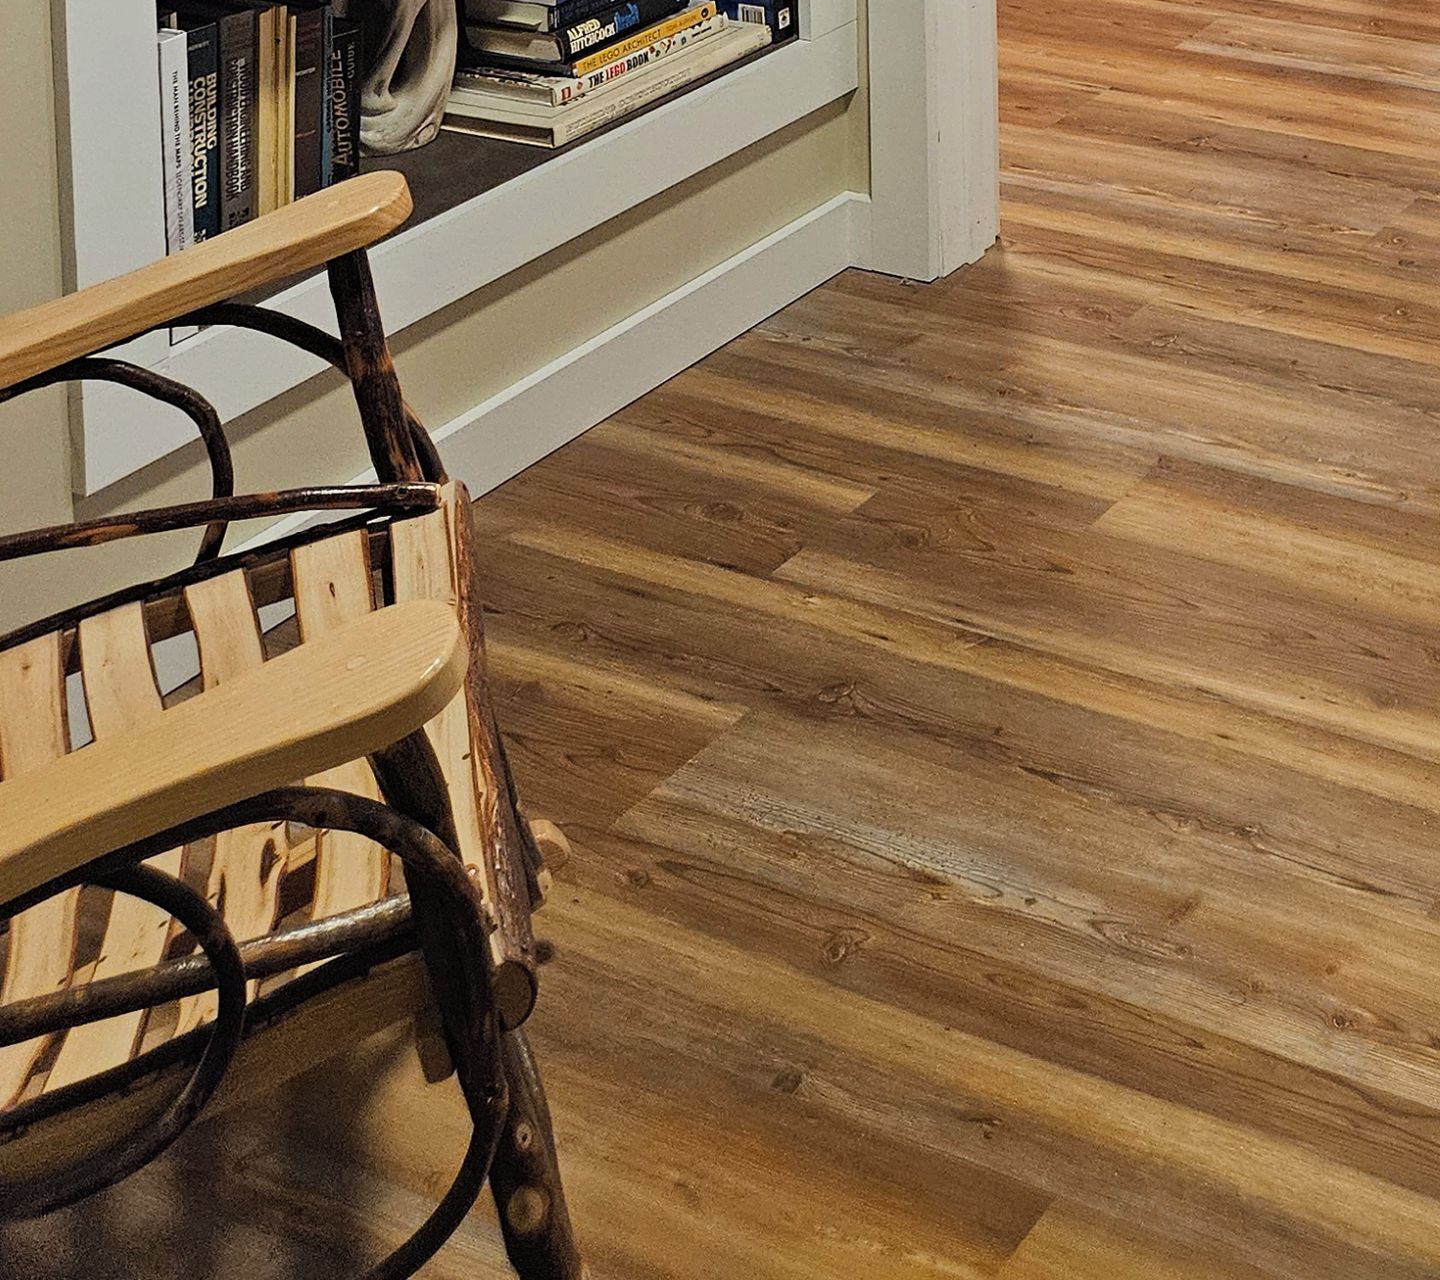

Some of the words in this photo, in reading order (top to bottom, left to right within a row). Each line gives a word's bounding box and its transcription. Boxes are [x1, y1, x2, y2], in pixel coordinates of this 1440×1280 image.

[567, 18, 601, 42] ALFRED
[569, 22, 617, 54] HITCHCOCK
[582, 57, 597, 70] THE
[599, 48, 620, 64] LEGO
[622, 28, 661, 55] ARCHITECT
[239, 65, 249, 97] WOOD
[588, 73, 605, 88] THE
[605, 63, 626, 81] LEGO
[626, 51, 650, 71] BOOK
[206, 72, 217, 150] BUILDING
[225, 57, 239, 138] CONSTRUCTION
[331, 48, 354, 167] AUTOMOBILE
[193, 76, 207, 209] CONSTRUCTION
[239, 98, 251, 168] ENGINEERING
[225, 139, 239, 202] HANDBOOK
[241, 169, 251, 192] AND
